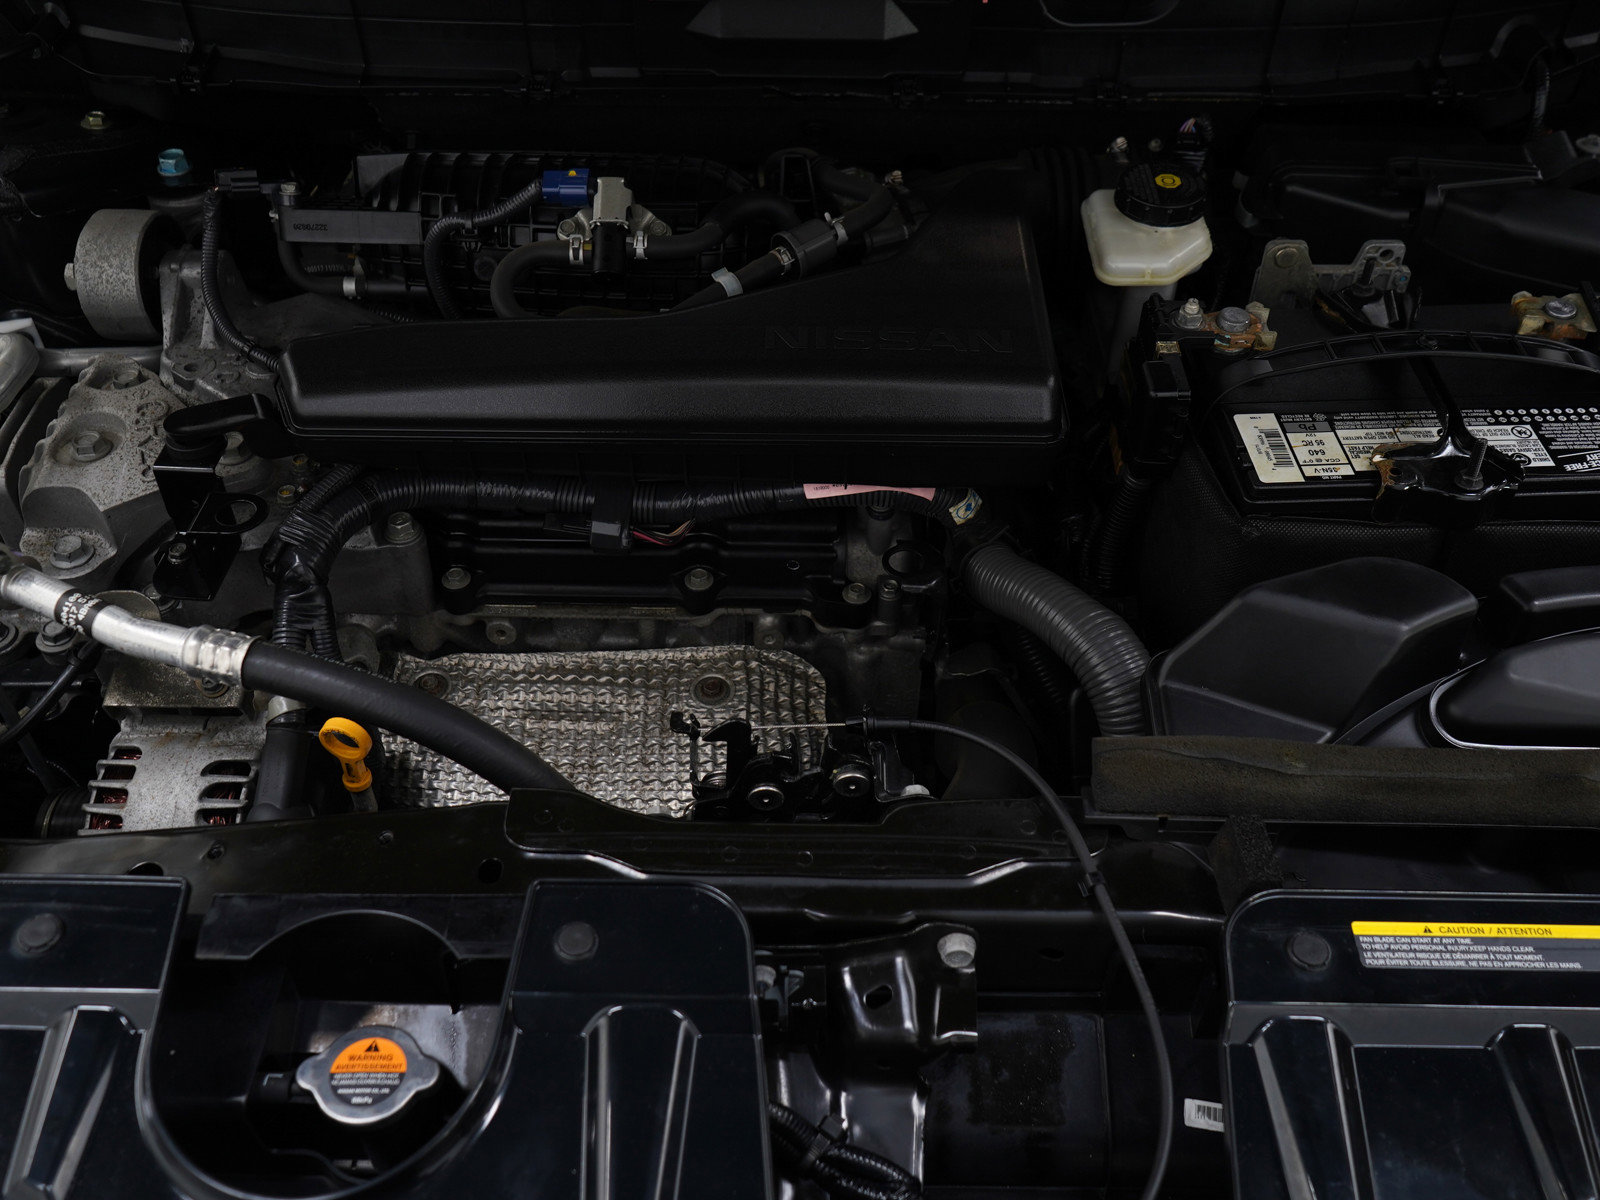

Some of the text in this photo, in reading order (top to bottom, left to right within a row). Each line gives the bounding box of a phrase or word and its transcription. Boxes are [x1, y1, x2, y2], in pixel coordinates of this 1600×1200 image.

[765, 326, 1013, 352] NISSAN
[1439, 926, 1485, 934] CAUTION
[1497, 927, 1553, 935] ATTENTION
[1452, 952, 1489, 960] DÉMARRER
